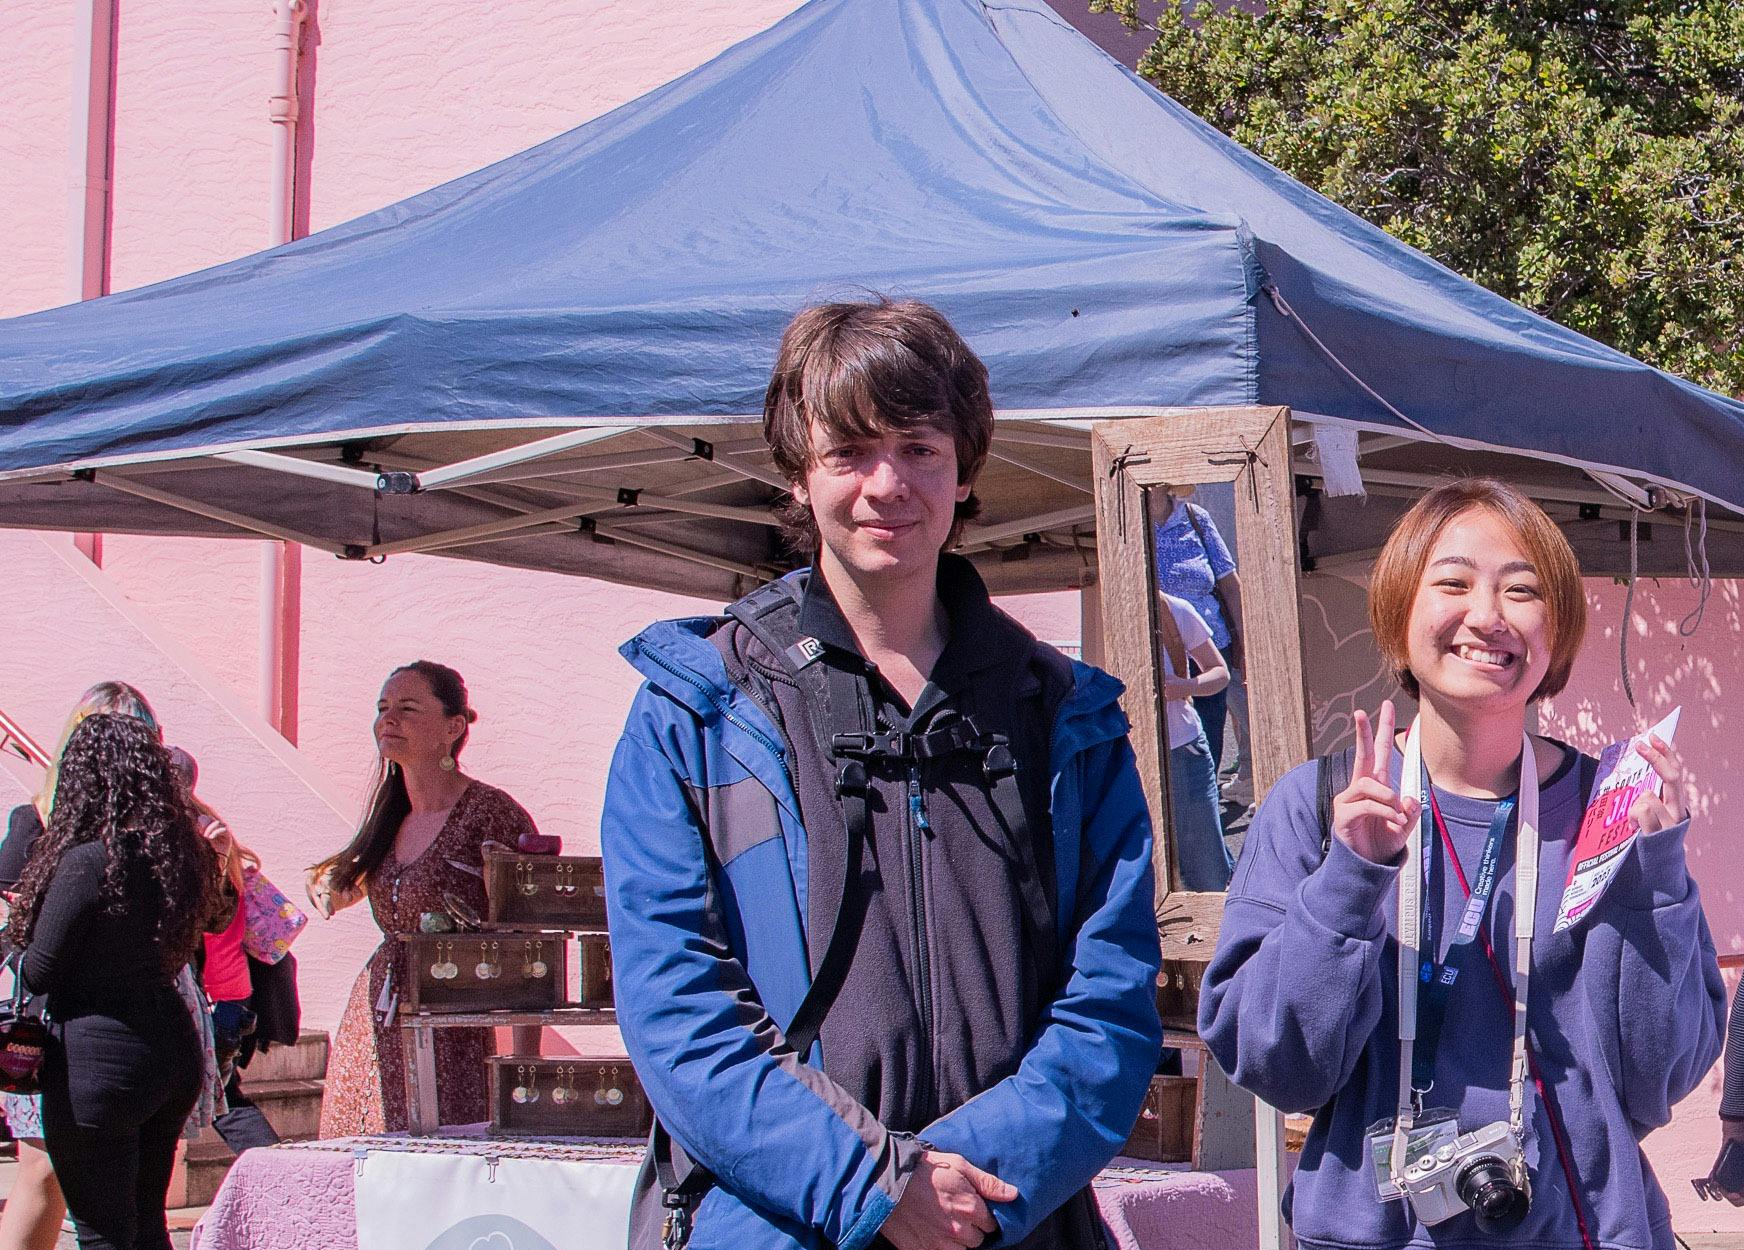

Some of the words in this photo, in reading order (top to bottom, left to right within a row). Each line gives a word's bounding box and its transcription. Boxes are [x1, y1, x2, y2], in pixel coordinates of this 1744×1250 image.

[1474, 865, 1488, 895] Creative
[1483, 837, 1495, 865] thinkers
[1404, 874, 1417, 895] PEN
[1482, 876, 1493, 896] made
[1404, 898, 1417, 948] OLYMPUS
[1459, 898, 1485, 937] ECU
[1440, 968, 1454, 985] ECU
